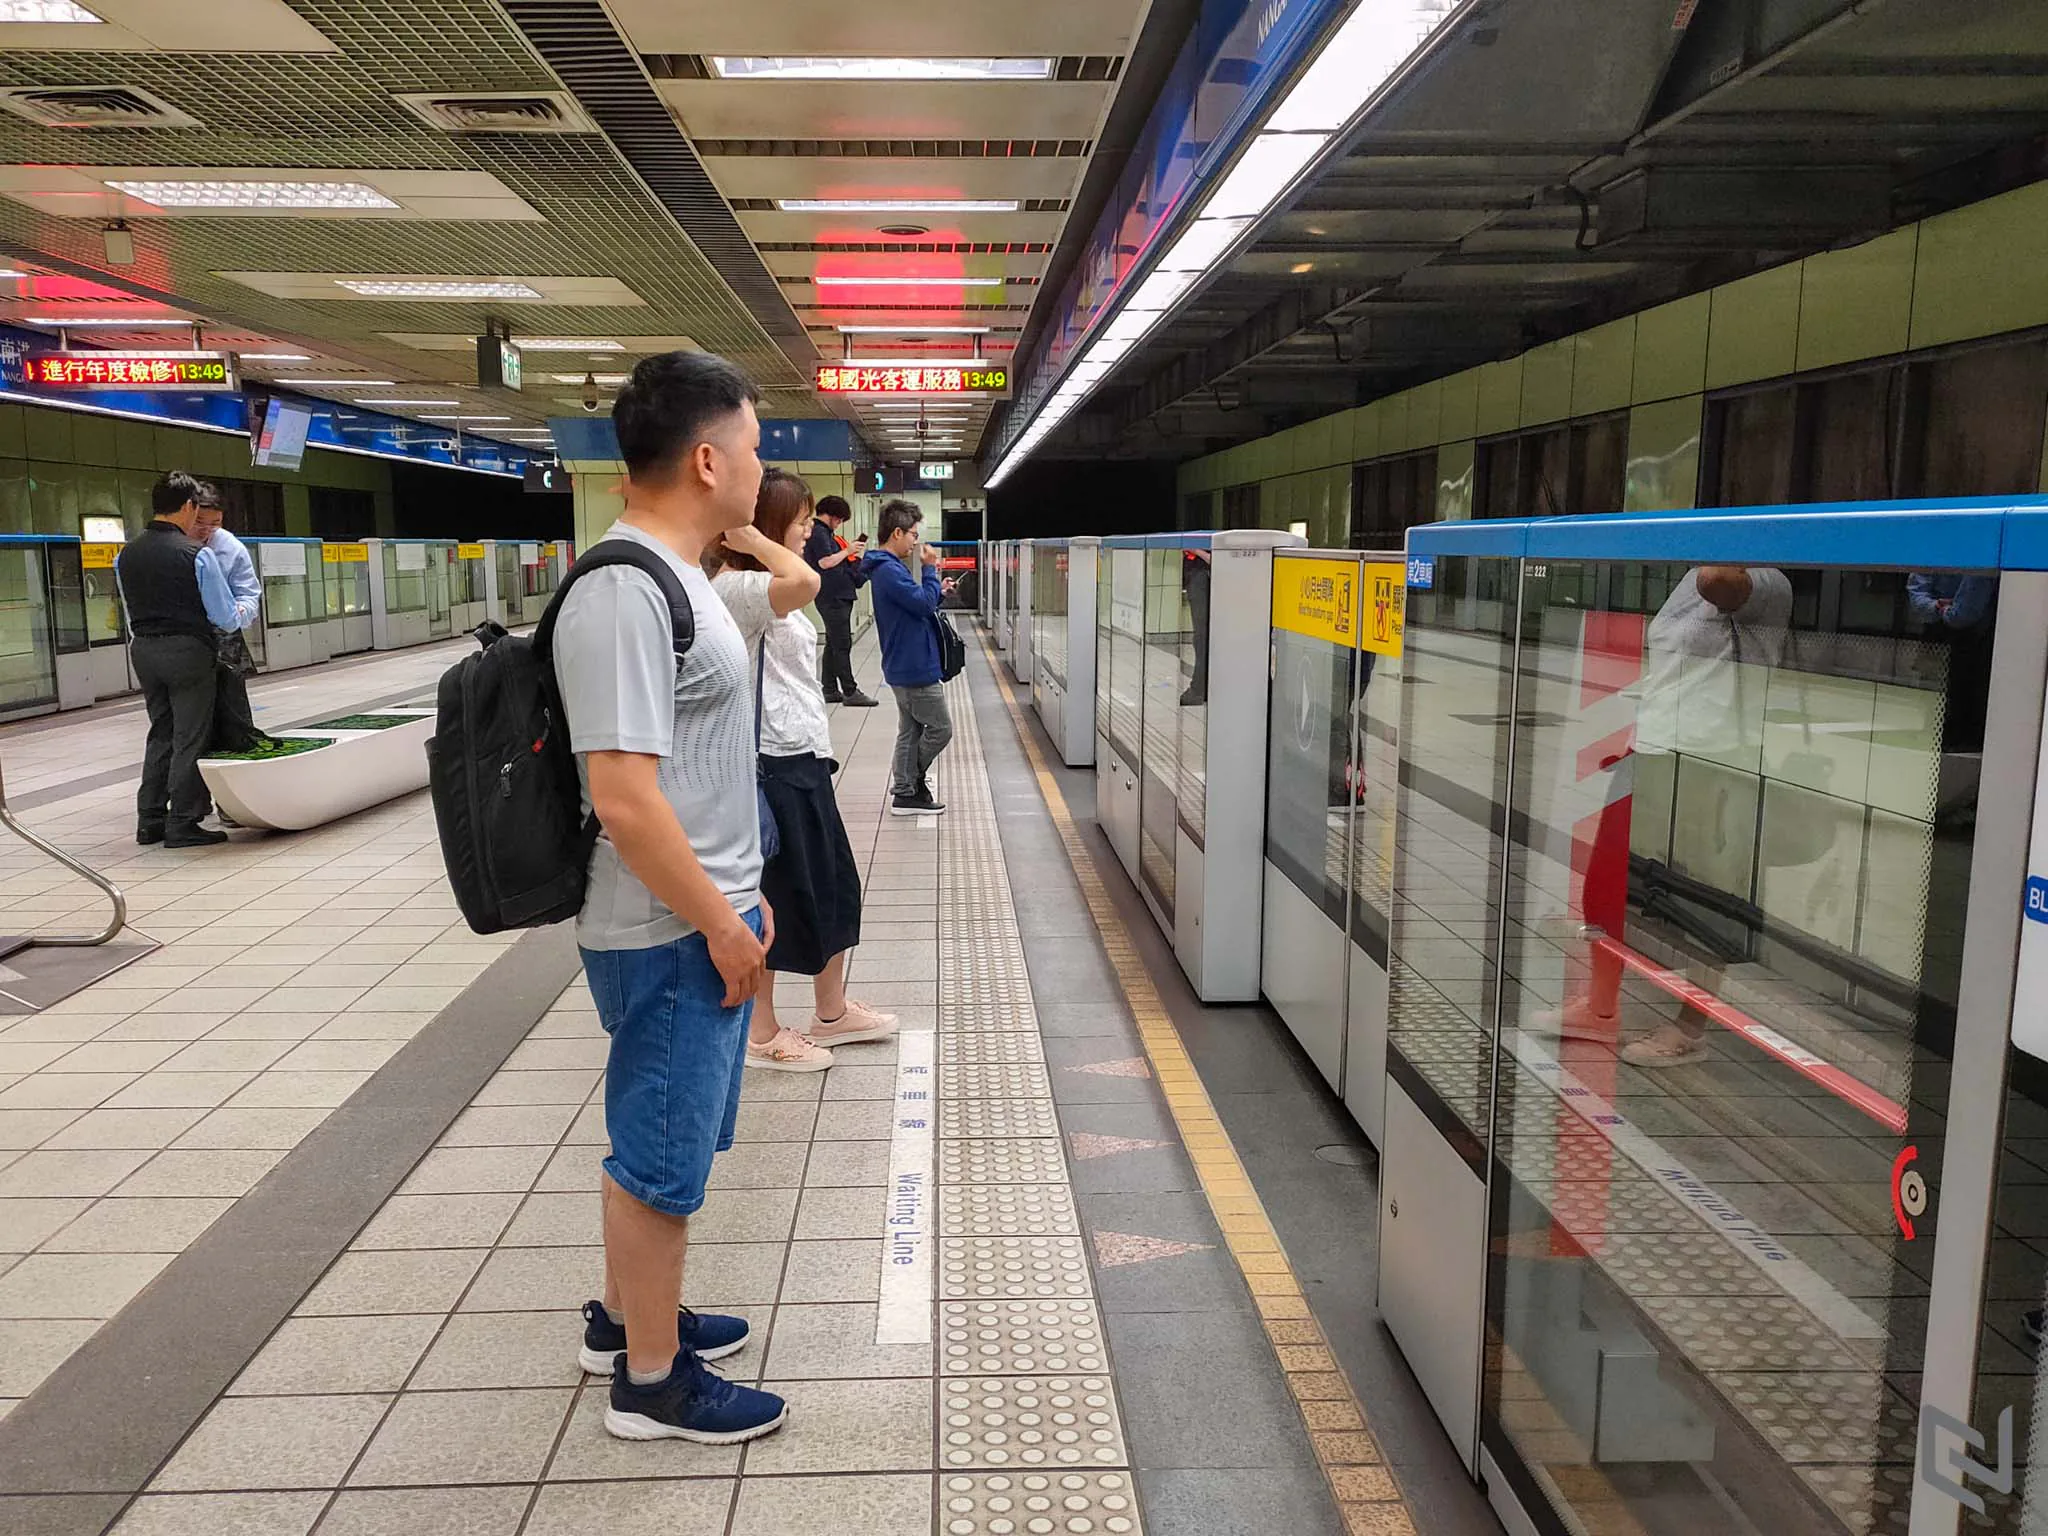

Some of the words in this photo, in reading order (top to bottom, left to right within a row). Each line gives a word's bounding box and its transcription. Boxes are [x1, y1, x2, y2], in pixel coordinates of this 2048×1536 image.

[179, 363, 225, 380] 13:49
[961, 371, 1006, 388] 13:49
[889, 1172, 923, 1226] Waiting
[892, 1231, 921, 1266] Line
